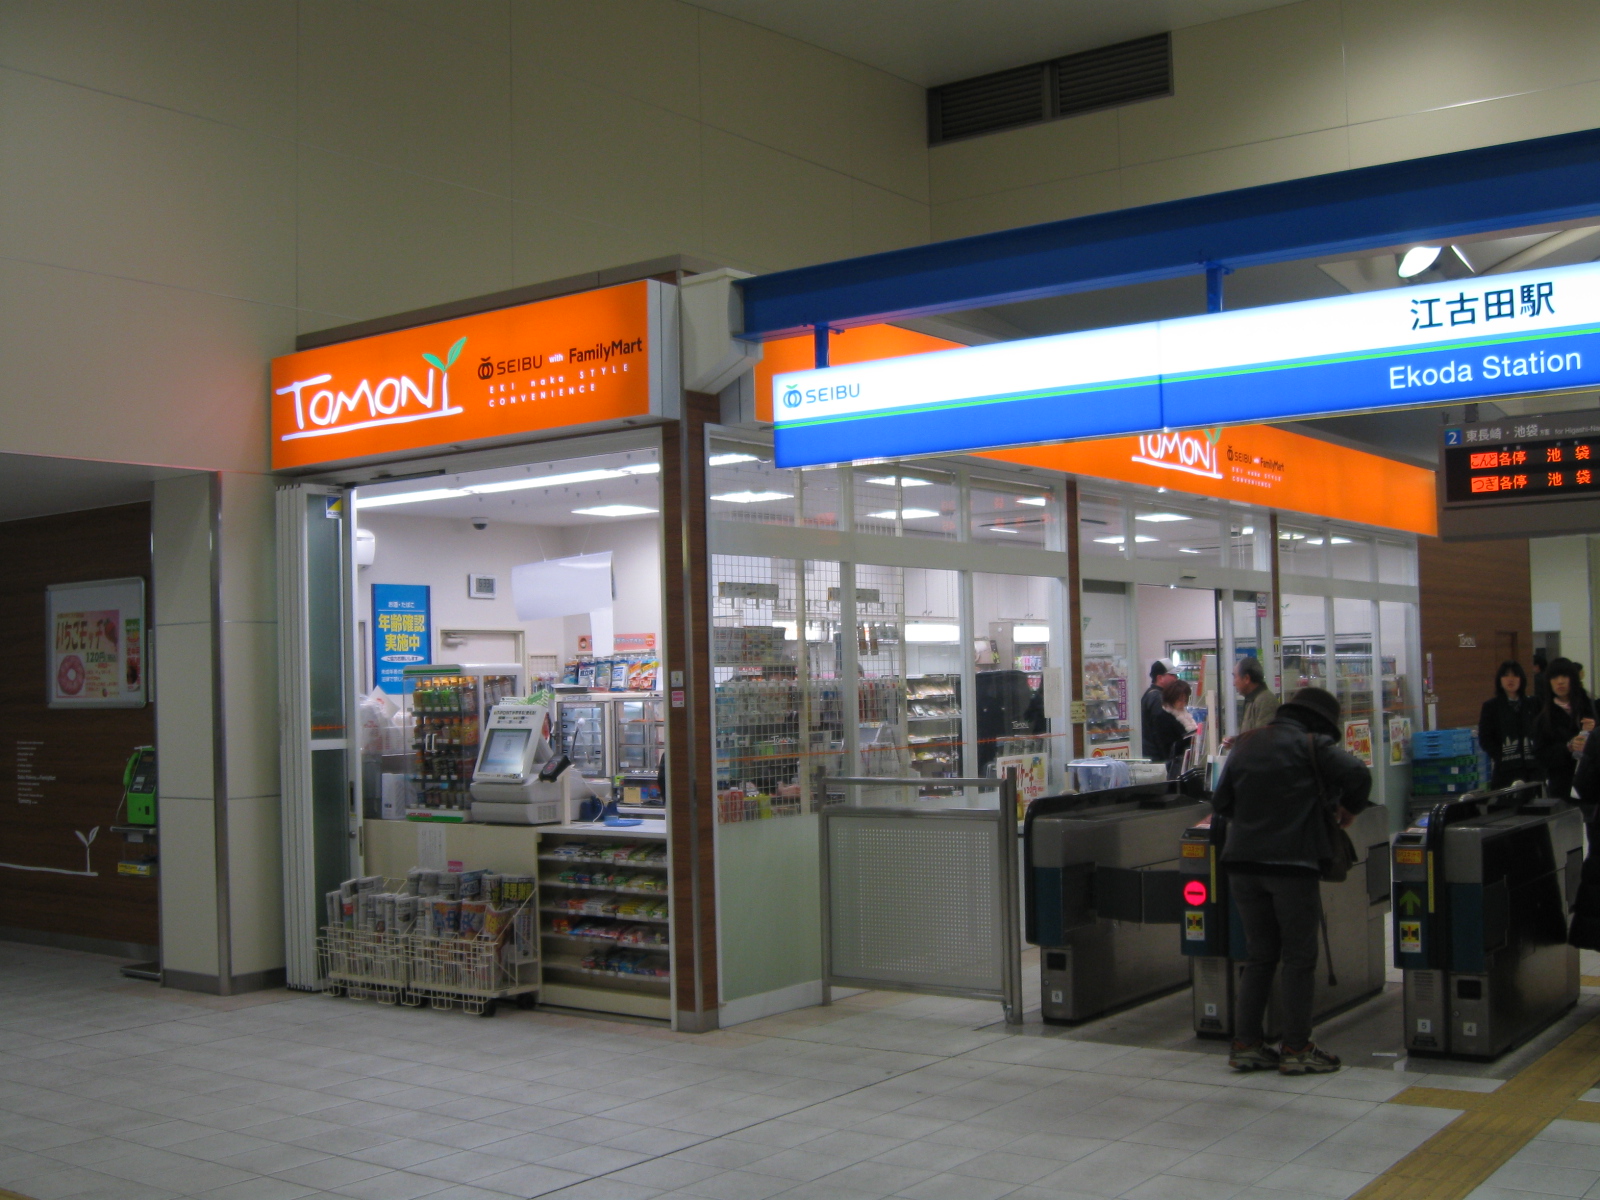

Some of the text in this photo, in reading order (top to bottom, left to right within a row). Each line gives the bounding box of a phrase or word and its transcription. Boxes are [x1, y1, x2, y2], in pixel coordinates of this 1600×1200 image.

[1410, 281, 1555, 331] 江古田駅
[496, 337, 643, 375] SEIBU with FamilyMart
[488, 363, 629, 394] EKI naka STYLE
[1389, 350, 1582, 389] Ekoda Station
[488, 383, 596, 408] CONVENIENCE
[806, 382, 861, 404] SEIBU
[1447, 431, 1458, 445] 2
[1555, 428, 1564, 436] for
[1234, 451, 1252, 465] SEIBU
[1471, 453, 1498, 469] こんど
[1499, 451, 1527, 467] 各停
[1473, 477, 1498, 491] つぎ
[1500, 474, 1528, 490] 各停
[378, 613, 426, 633] 年齢確認
[385, 633, 420, 652] 実施中
[1207, 1005, 1214, 1013] 6
[1421, 1022, 1427, 1030] 5
